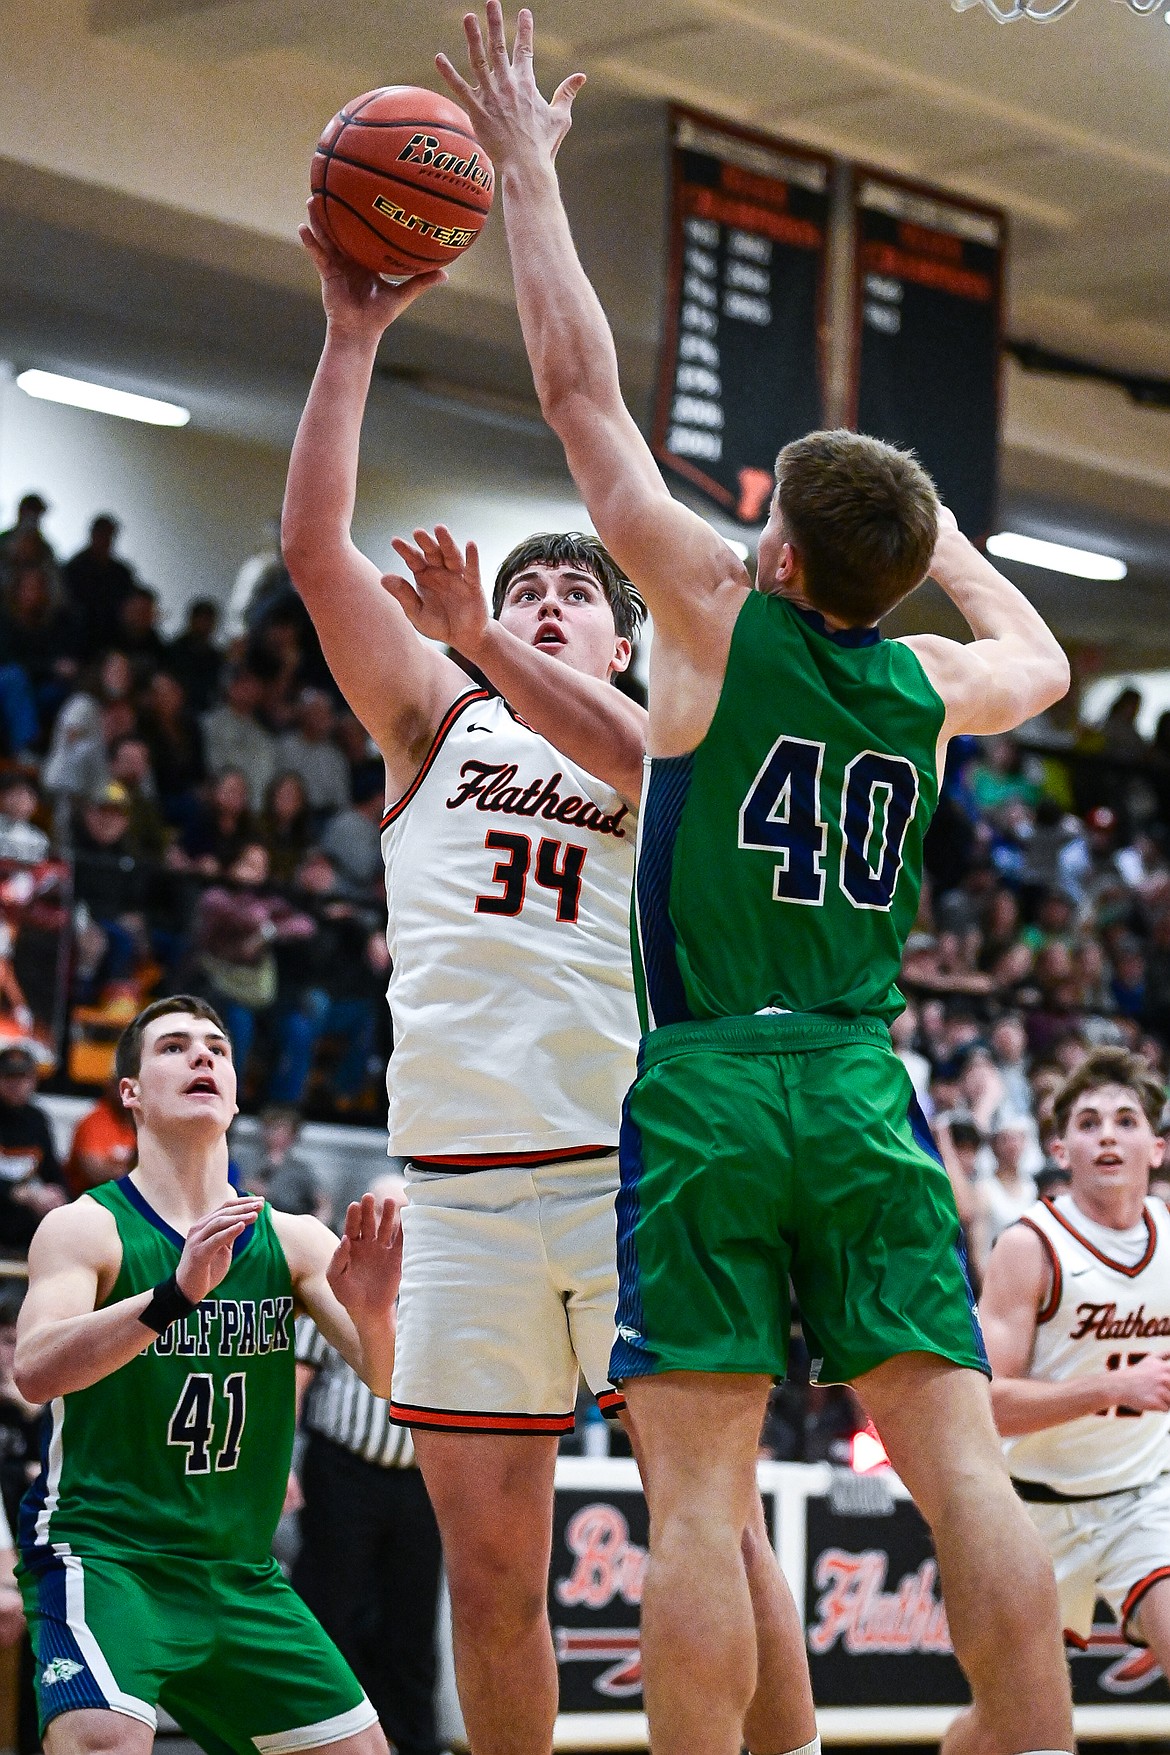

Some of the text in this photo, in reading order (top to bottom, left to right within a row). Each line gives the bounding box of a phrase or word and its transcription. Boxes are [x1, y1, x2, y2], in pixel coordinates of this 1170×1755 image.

[396, 133, 493, 193] Baden
[446, 759, 626, 838] Flathead
[738, 734, 921, 912] 40
[474, 830, 588, 923] 34
[139, 1296, 294, 1357] OLFPACK
[1069, 1301, 1170, 1341] Flathea
[167, 1372, 247, 1475] 41
